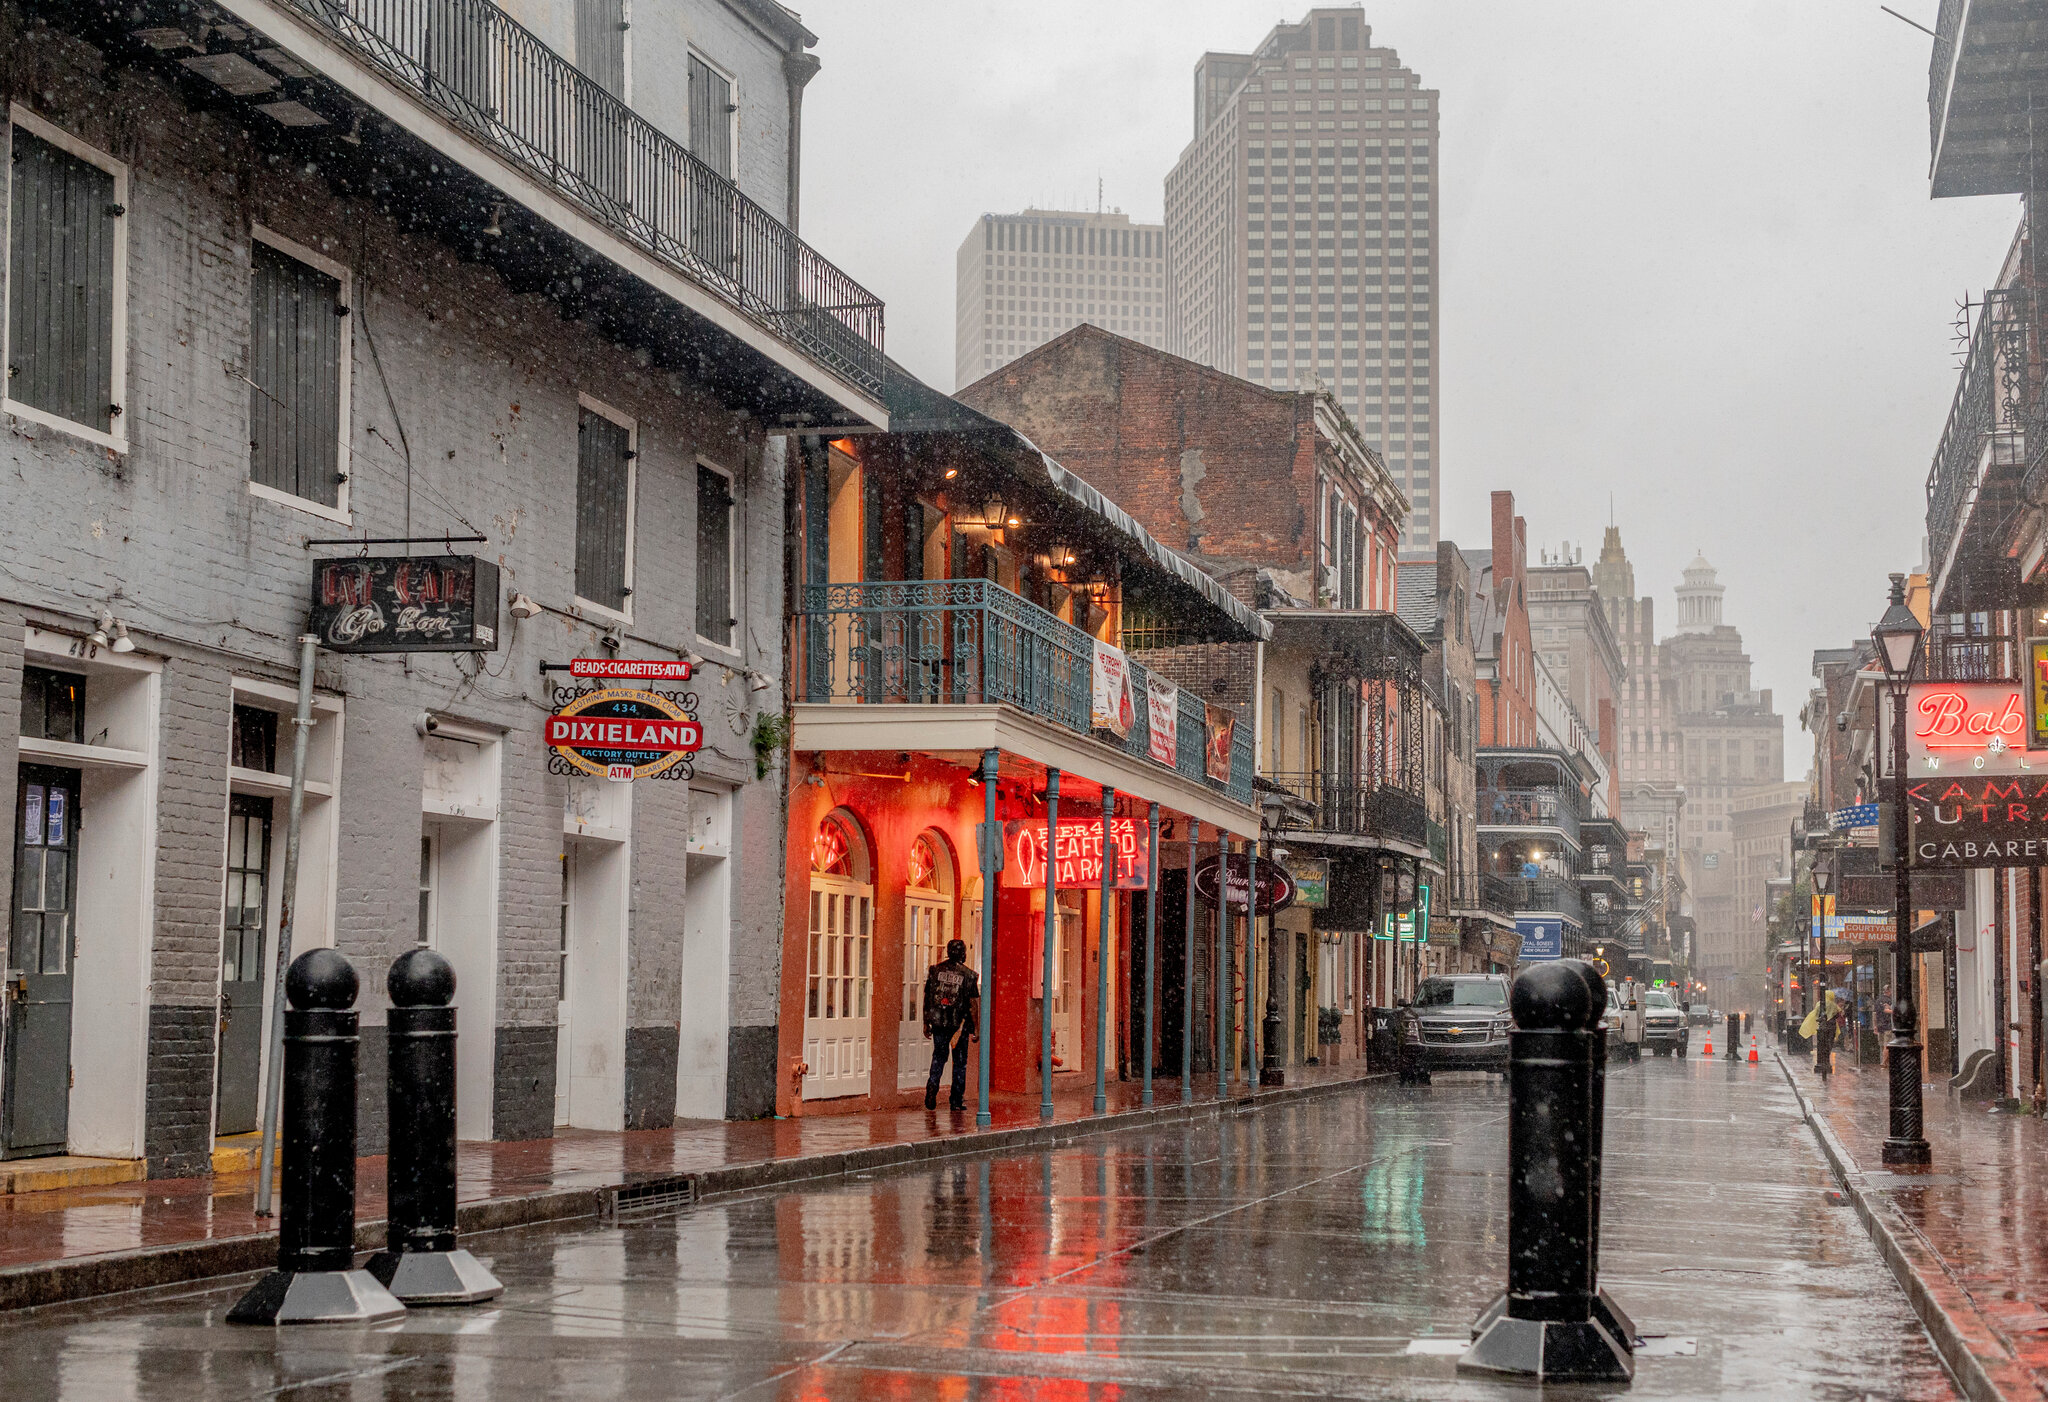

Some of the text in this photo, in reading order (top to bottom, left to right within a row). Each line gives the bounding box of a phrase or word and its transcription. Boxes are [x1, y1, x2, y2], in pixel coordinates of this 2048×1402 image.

[569, 690, 682, 719] CLOTHING MASKS BEADS CIGAR
[612, 703, 637, 713] 434
[552, 721, 697, 746] DIXIELAND
[564, 748, 605, 774] SOFT DRINKS
[581, 749, 662, 760] FACTORY OUTLET
[635, 753, 679, 776] CIGARETTES
[609, 766, 632, 779] ATM
[1041, 855, 1136, 883] MARKT
[1843, 932, 1865, 940] LIVE
